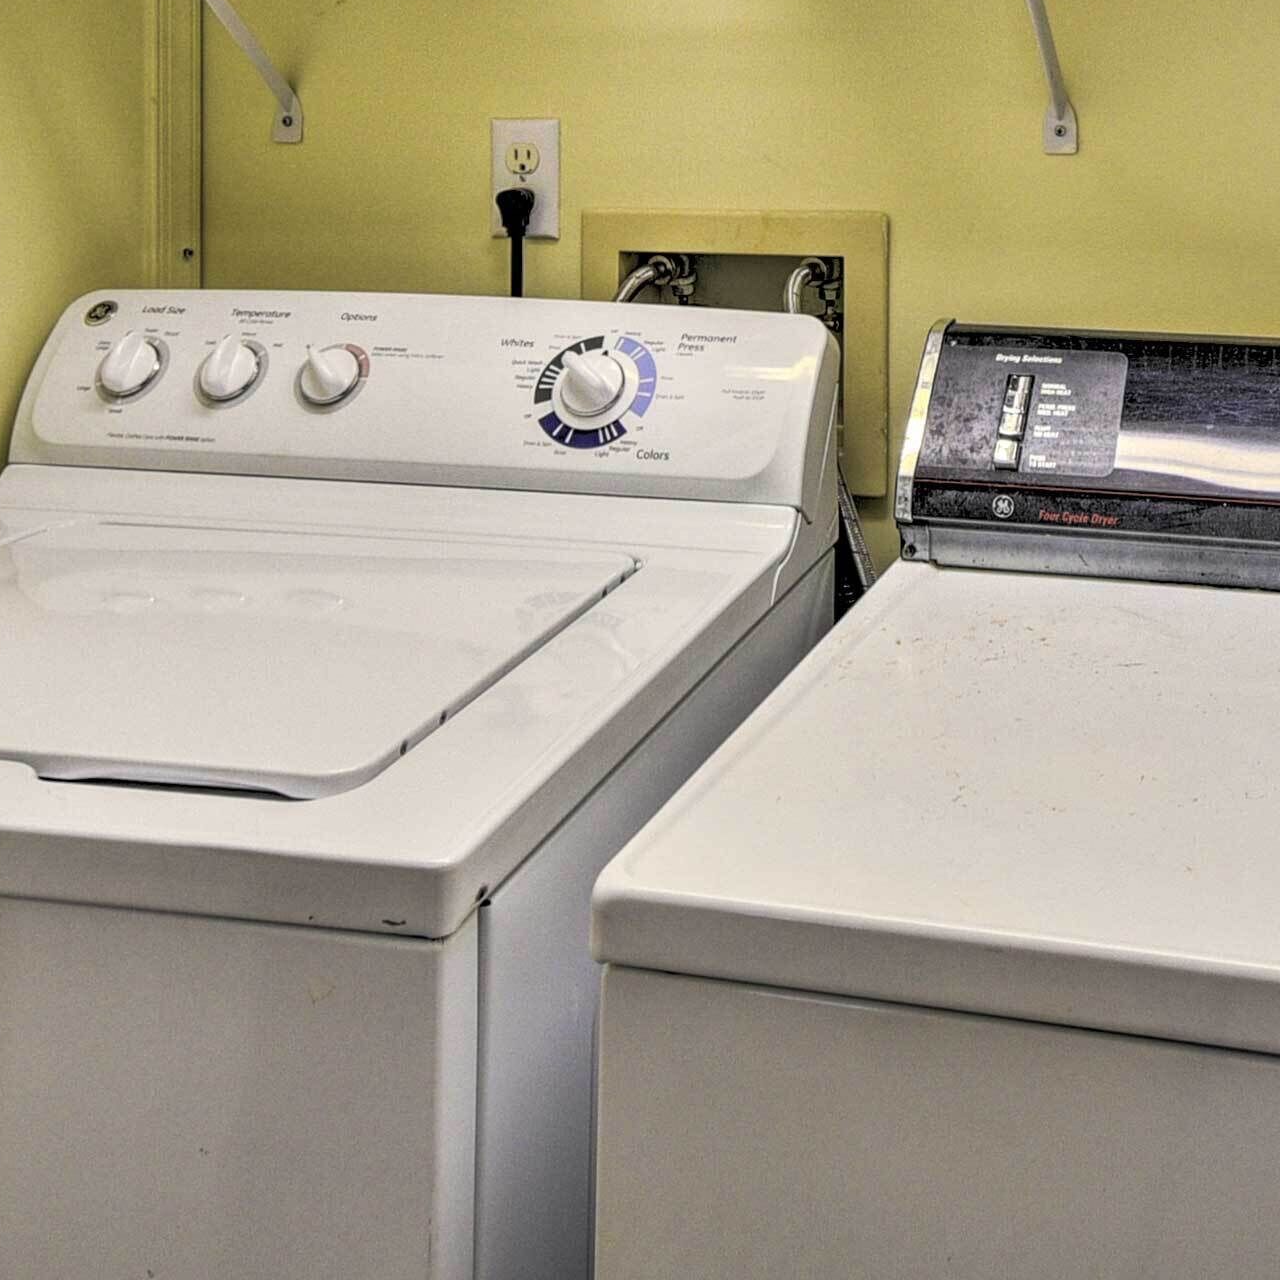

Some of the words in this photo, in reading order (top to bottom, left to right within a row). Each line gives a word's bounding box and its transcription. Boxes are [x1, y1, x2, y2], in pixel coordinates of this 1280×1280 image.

[142, 305, 166, 314] Load
[168, 306, 186, 315] Size
[231, 308, 291, 319] Temperature
[341, 312, 377, 322] Options
[501, 338, 535, 348] Whites
[681, 333, 737, 344] Permanent
[678, 342, 705, 352] Press
[995, 353, 1020, 364] Drying
[1022, 354, 1063, 364] Selections
[636, 449, 670, 461] Colors
[1039, 509, 1060, 522] Four
[1062, 511, 1089, 525] Cycle
[1091, 513, 1120, 526] Dryer
